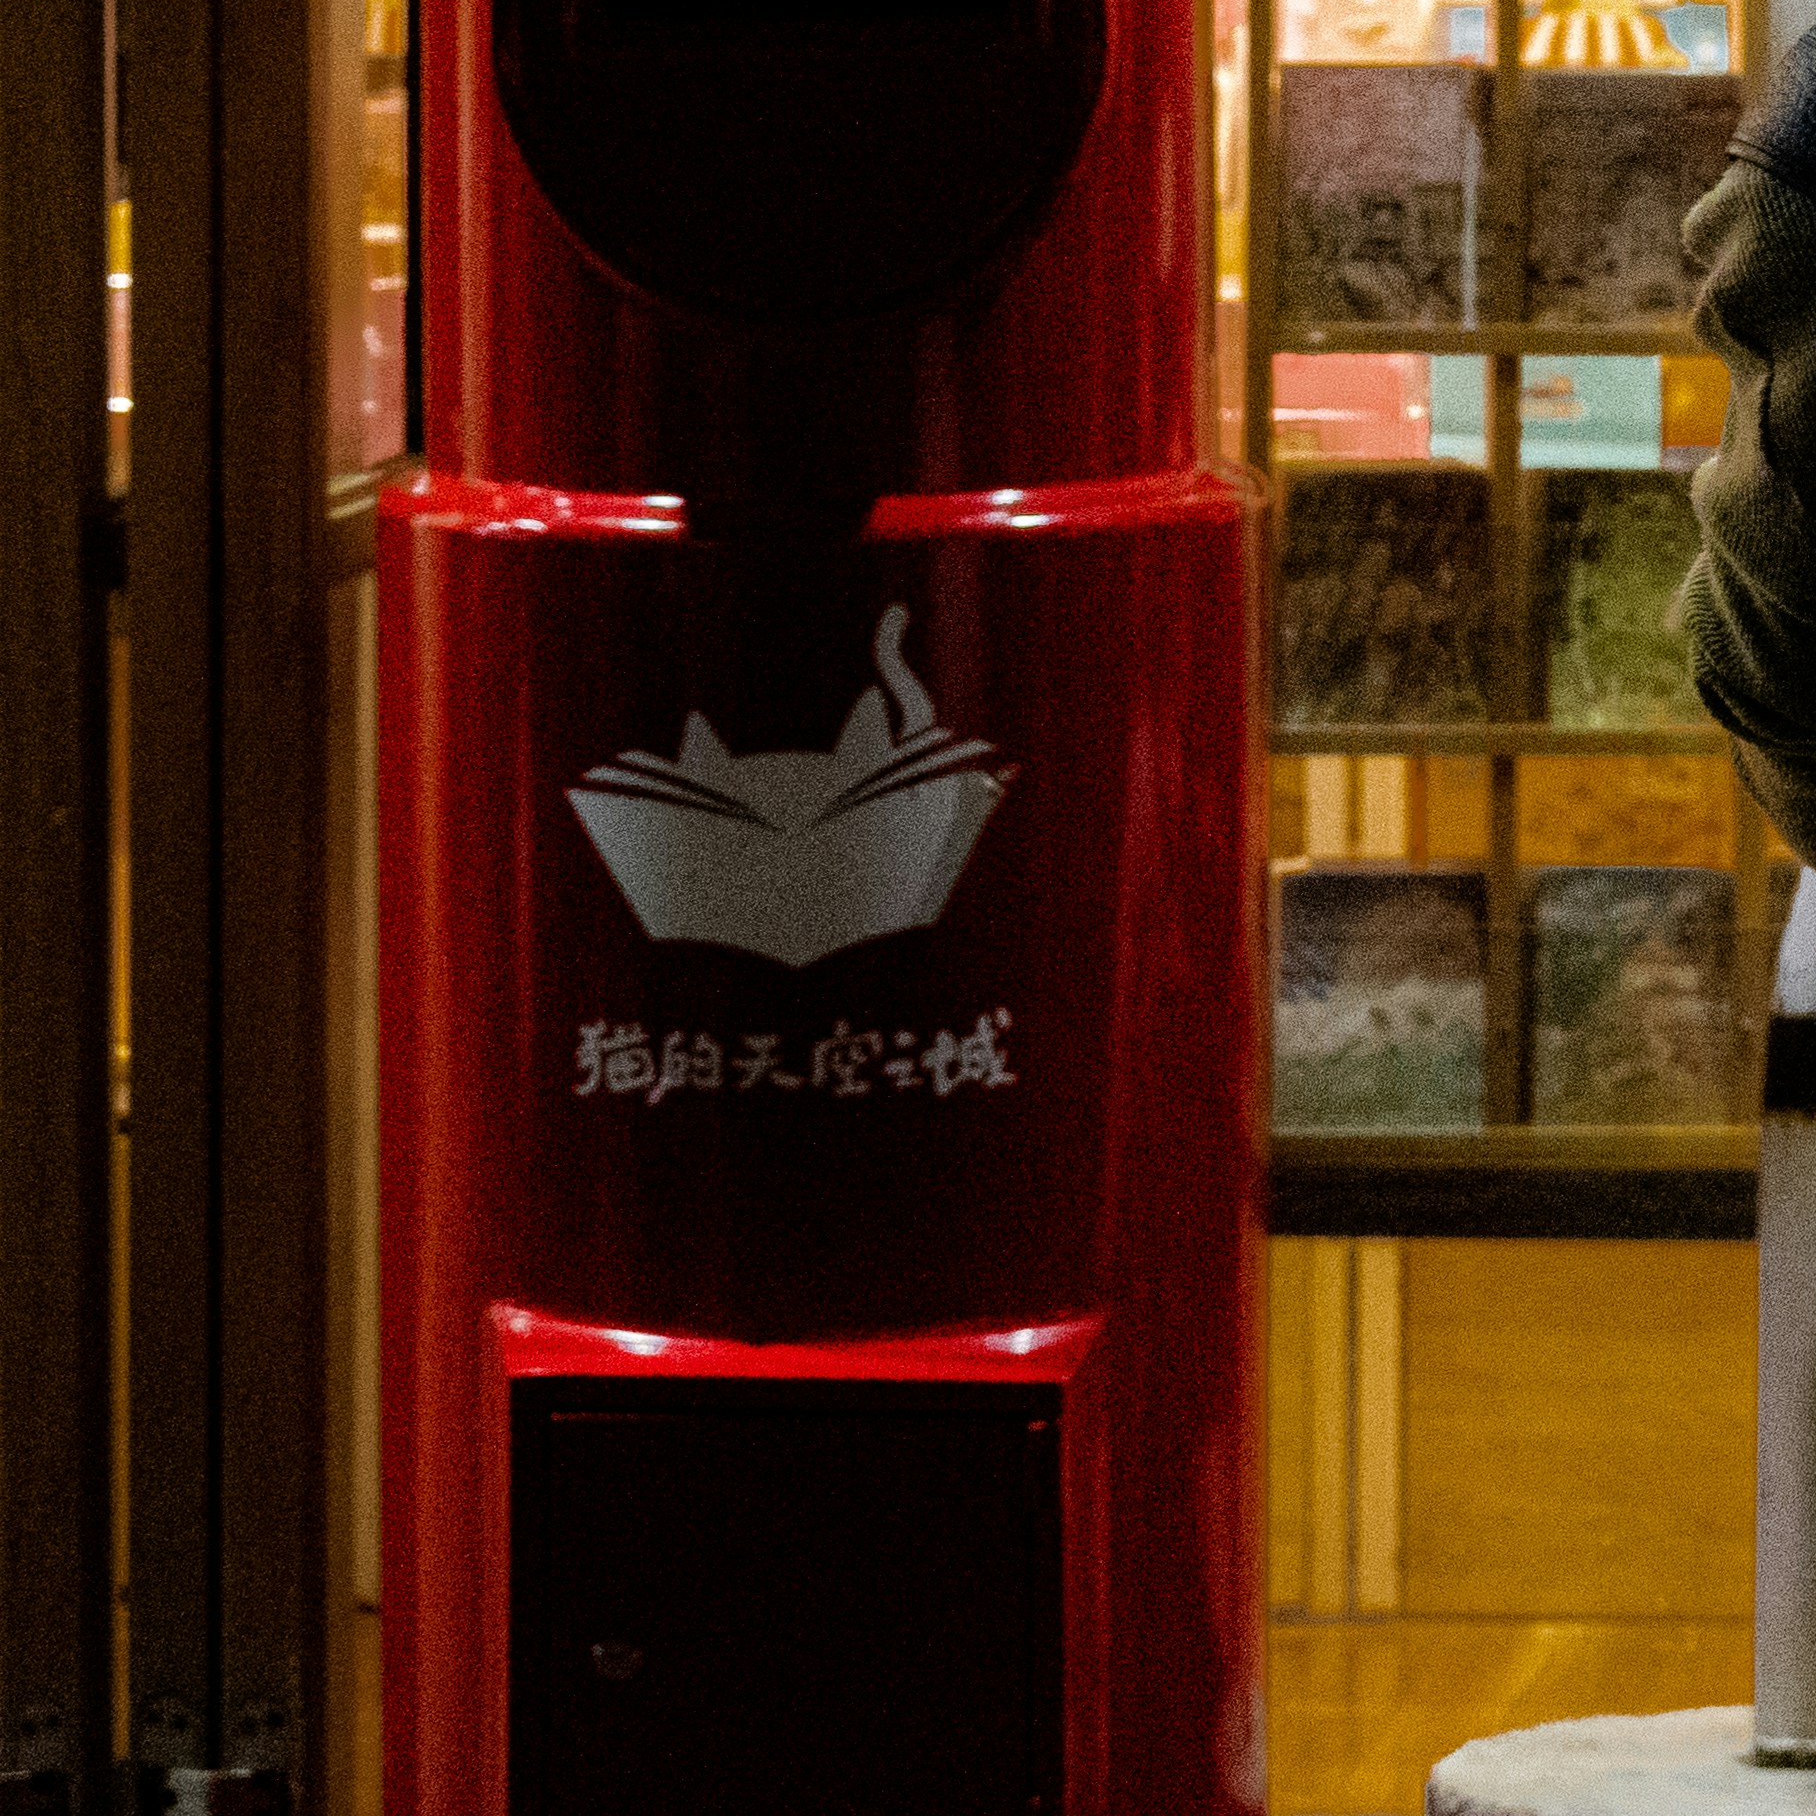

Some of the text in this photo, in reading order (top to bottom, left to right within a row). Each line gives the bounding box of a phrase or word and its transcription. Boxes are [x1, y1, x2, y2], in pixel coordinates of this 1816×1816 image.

[574, 1007, 1017, 1106] 猫的天空之城
